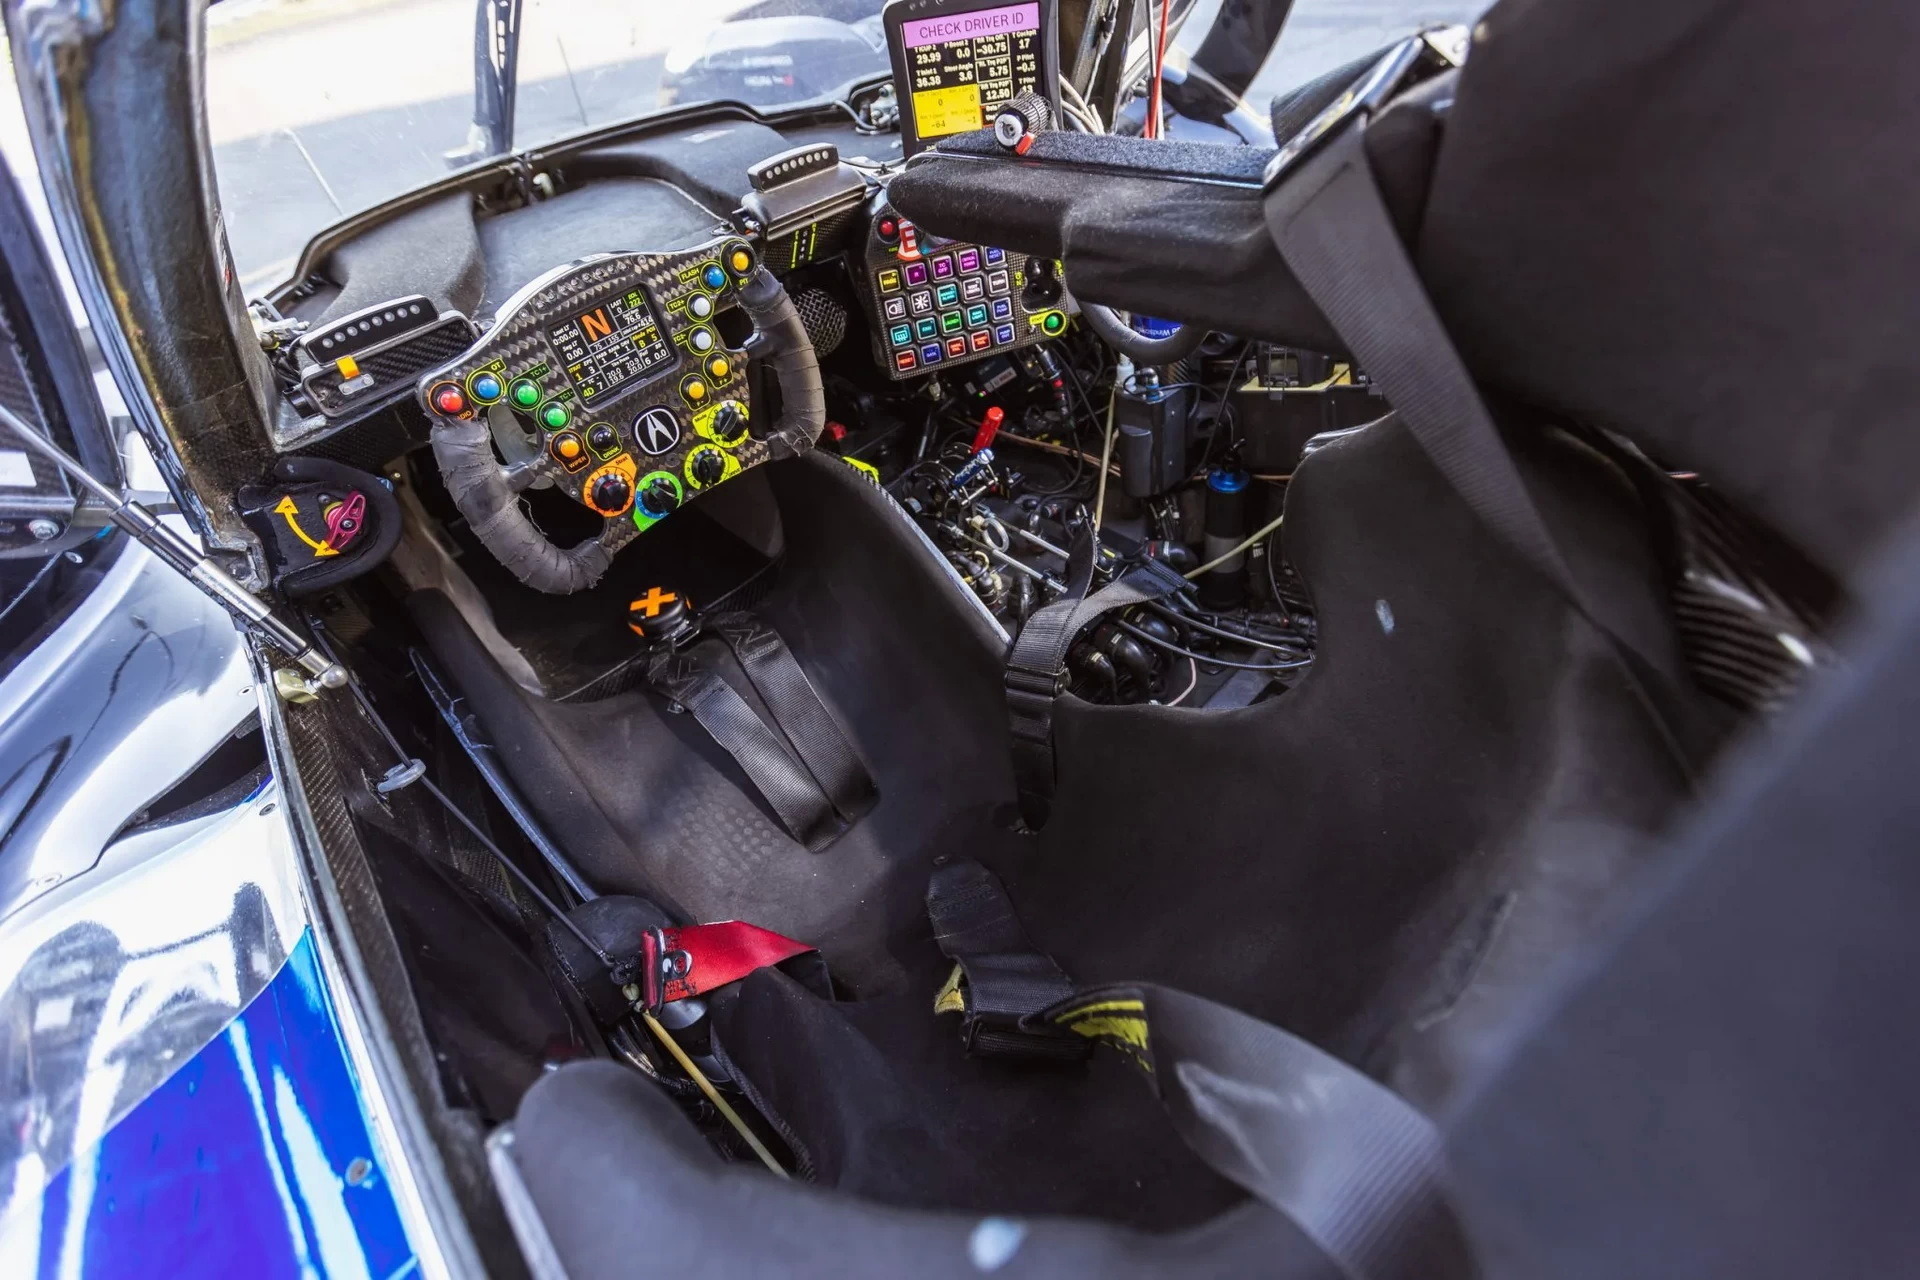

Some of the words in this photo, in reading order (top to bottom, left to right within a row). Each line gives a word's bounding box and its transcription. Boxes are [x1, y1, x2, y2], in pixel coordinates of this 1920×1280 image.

[919, 22, 961, 39] CHECK
[965, 14, 1009, 32] DRIVER
[1012, 12, 1024, 25] ID
[977, 41, 1007, 55] -30.75
[1019, 38, 1030, 49] 17
[916, 51, 941, 65] 29.99
[956, 47, 970, 59] 0.0
[989, 65, 1009, 77] 5.75
[1016, 61, 1036, 73] -0.5
[916, 75, 942, 88] 36.38
[959, 70, 973, 81] 3.6
[986, 88, 1010, 100] 12.50
[938, 98, 943, 106] 0
[681, 268, 699, 280] FLASH
[739, 277, 749, 286] PIT
[610, 299, 622, 309] LAST
[628, 297, 641, 308] 222
[625, 312, 641, 324] 76.6
[581, 308, 612, 341] N
[552, 328, 579, 346] 0:00.00
[651, 333, 658, 342] 5
[566, 347, 584, 361] 0.00
[653, 348, 667, 360] 0.0
[491, 362, 501, 371] OT
[644, 357, 651, 365] 6
[530, 367, 547, 377] TC1+
[575, 373, 583, 381] 1
[588, 366, 596, 375] 3
[606, 367, 622, 379] 20.0
[583, 387, 595, 397] 4D
[596, 381, 603, 390] 7
[602, 446, 620, 459] DRINK
[568, 456, 587, 469] WIPER
